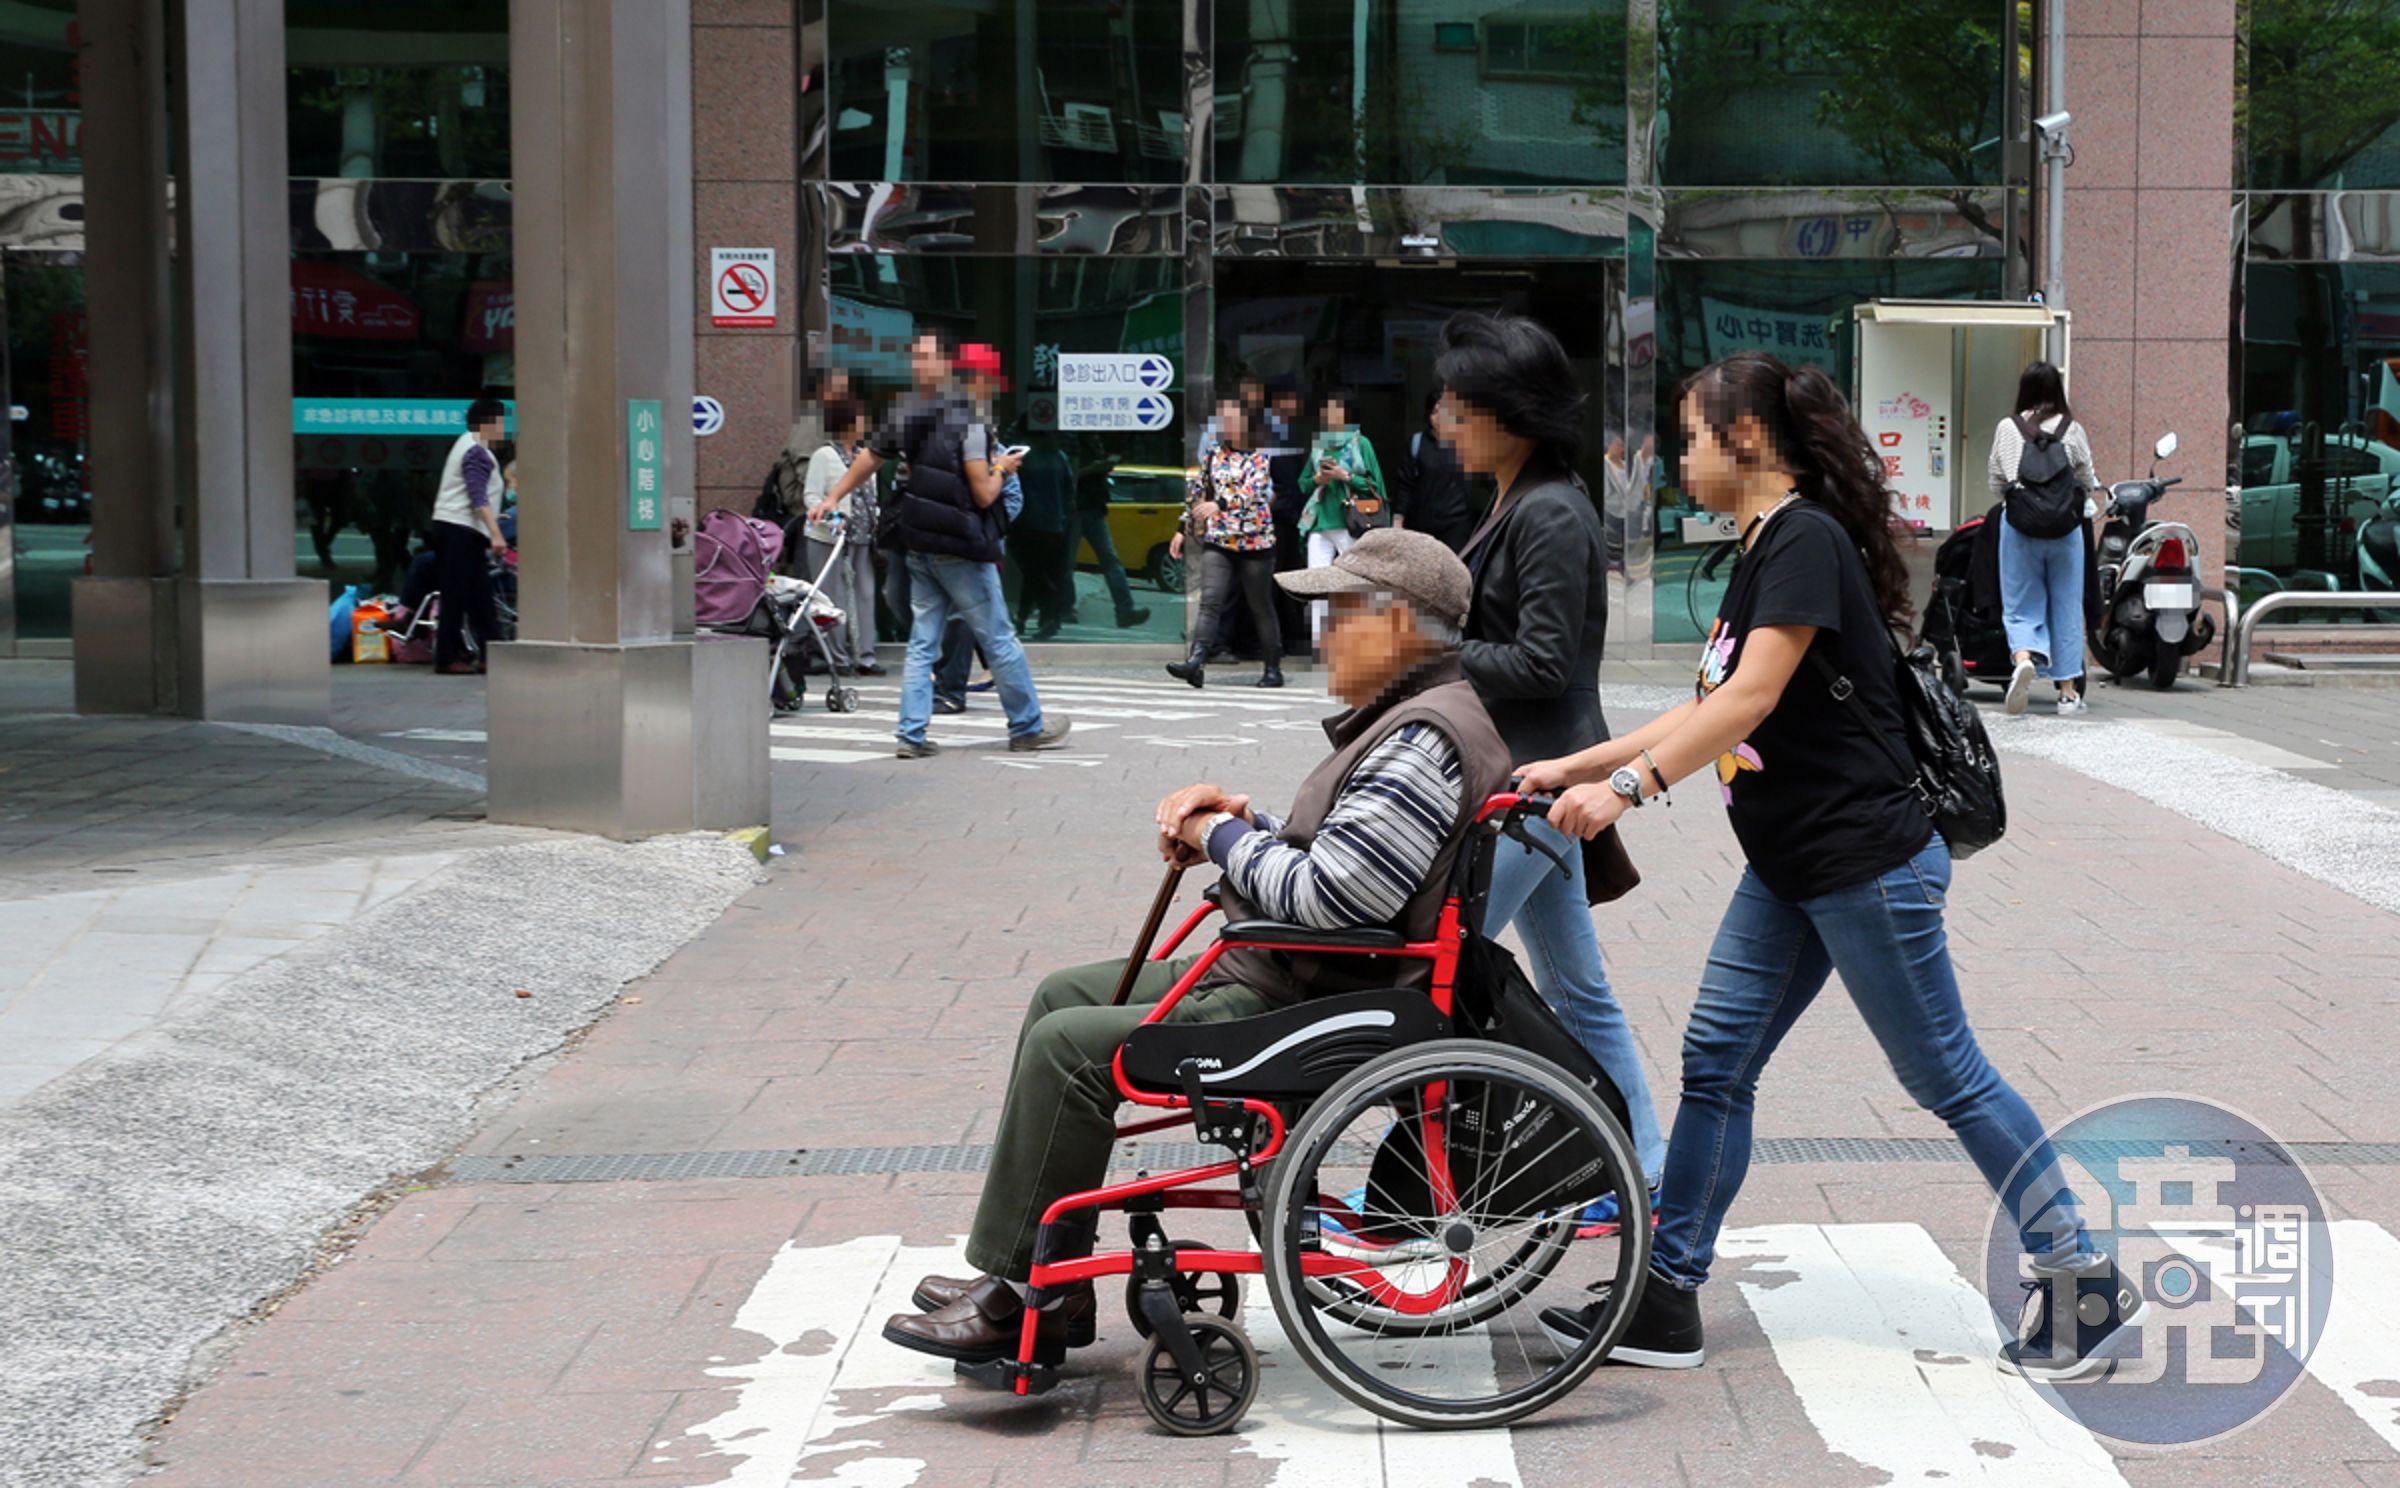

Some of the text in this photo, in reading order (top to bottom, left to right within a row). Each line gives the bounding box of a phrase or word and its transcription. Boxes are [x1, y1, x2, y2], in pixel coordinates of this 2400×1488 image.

[1063, 363, 1137, 383] 急診出入口
